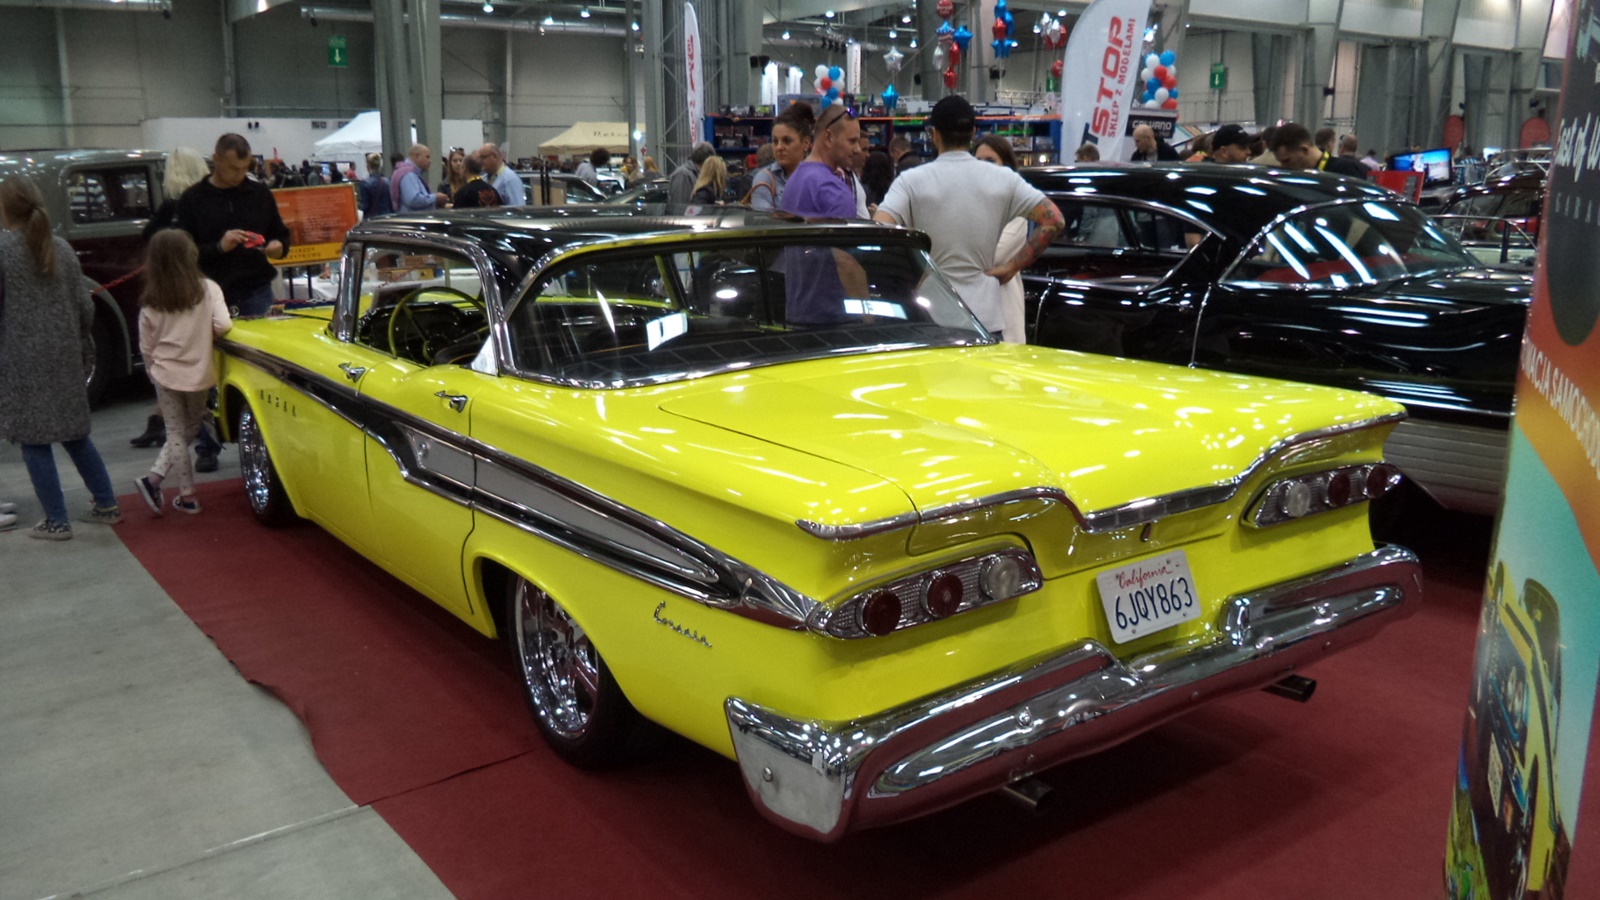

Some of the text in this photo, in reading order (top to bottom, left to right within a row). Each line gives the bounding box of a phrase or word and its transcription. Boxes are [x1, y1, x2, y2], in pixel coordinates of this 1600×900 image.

[1108, 100, 1120, 138] SKLEP
[1118, 18, 1136, 85] MODELAMI
[1115, 577, 1193, 630] 6JQY863
[1118, 566, 1173, 589] California
